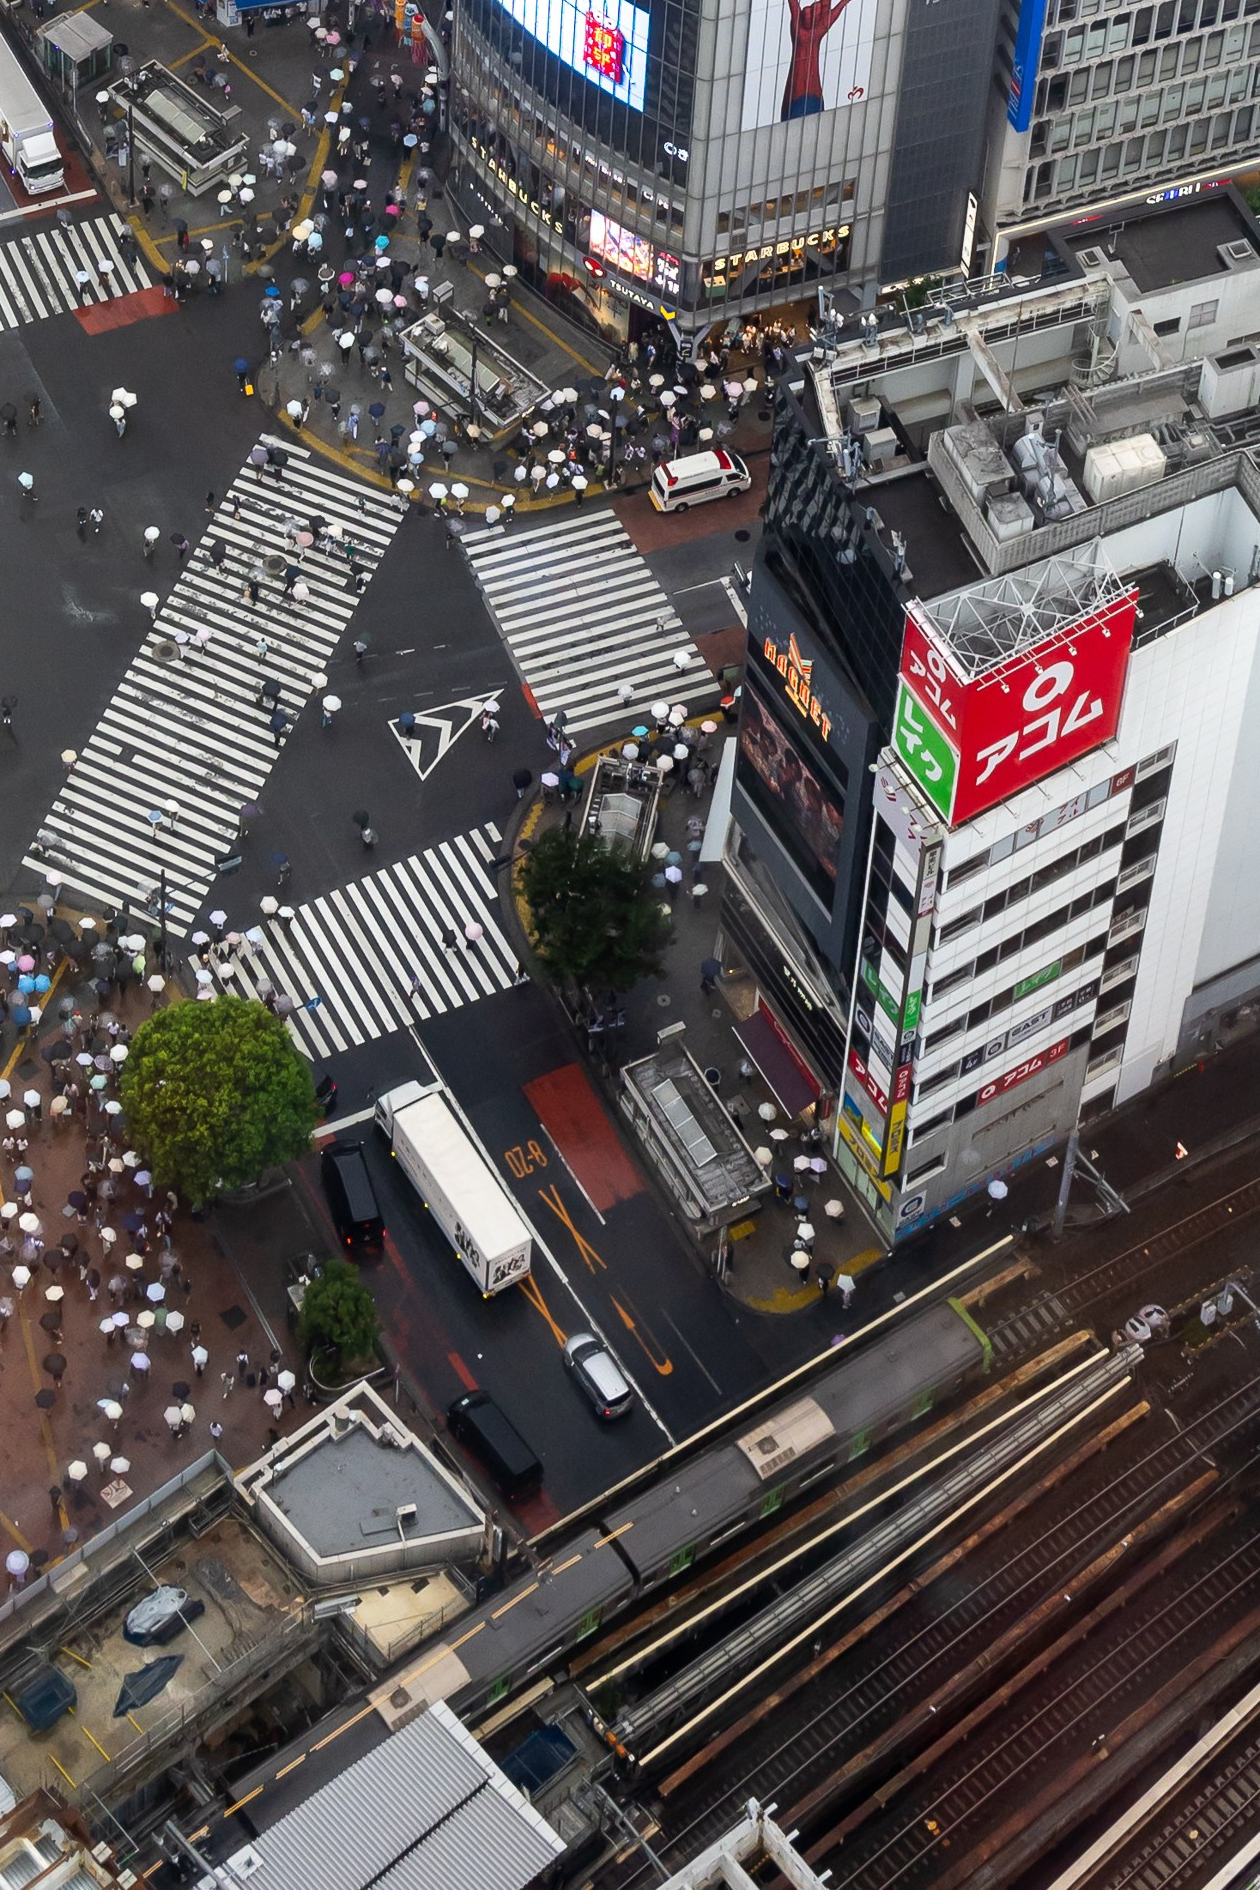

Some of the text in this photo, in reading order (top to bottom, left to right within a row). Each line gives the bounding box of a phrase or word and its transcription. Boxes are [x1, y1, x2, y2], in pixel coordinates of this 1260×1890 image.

[471, 135, 564, 235] STARBUCKS
[714, 225, 850, 271] STARBUCKS
[609, 278, 656, 311] TSUTAYA
[910, 650, 957, 731] アコム
[900, 694, 943, 782] レイク
[975, 689, 1104, 787] アコム
[1003, 1055, 1042, 1087] アコム
[1049, 1042, 1066, 1059] 3F
[504, 1140, 548, 1178] 8-20
